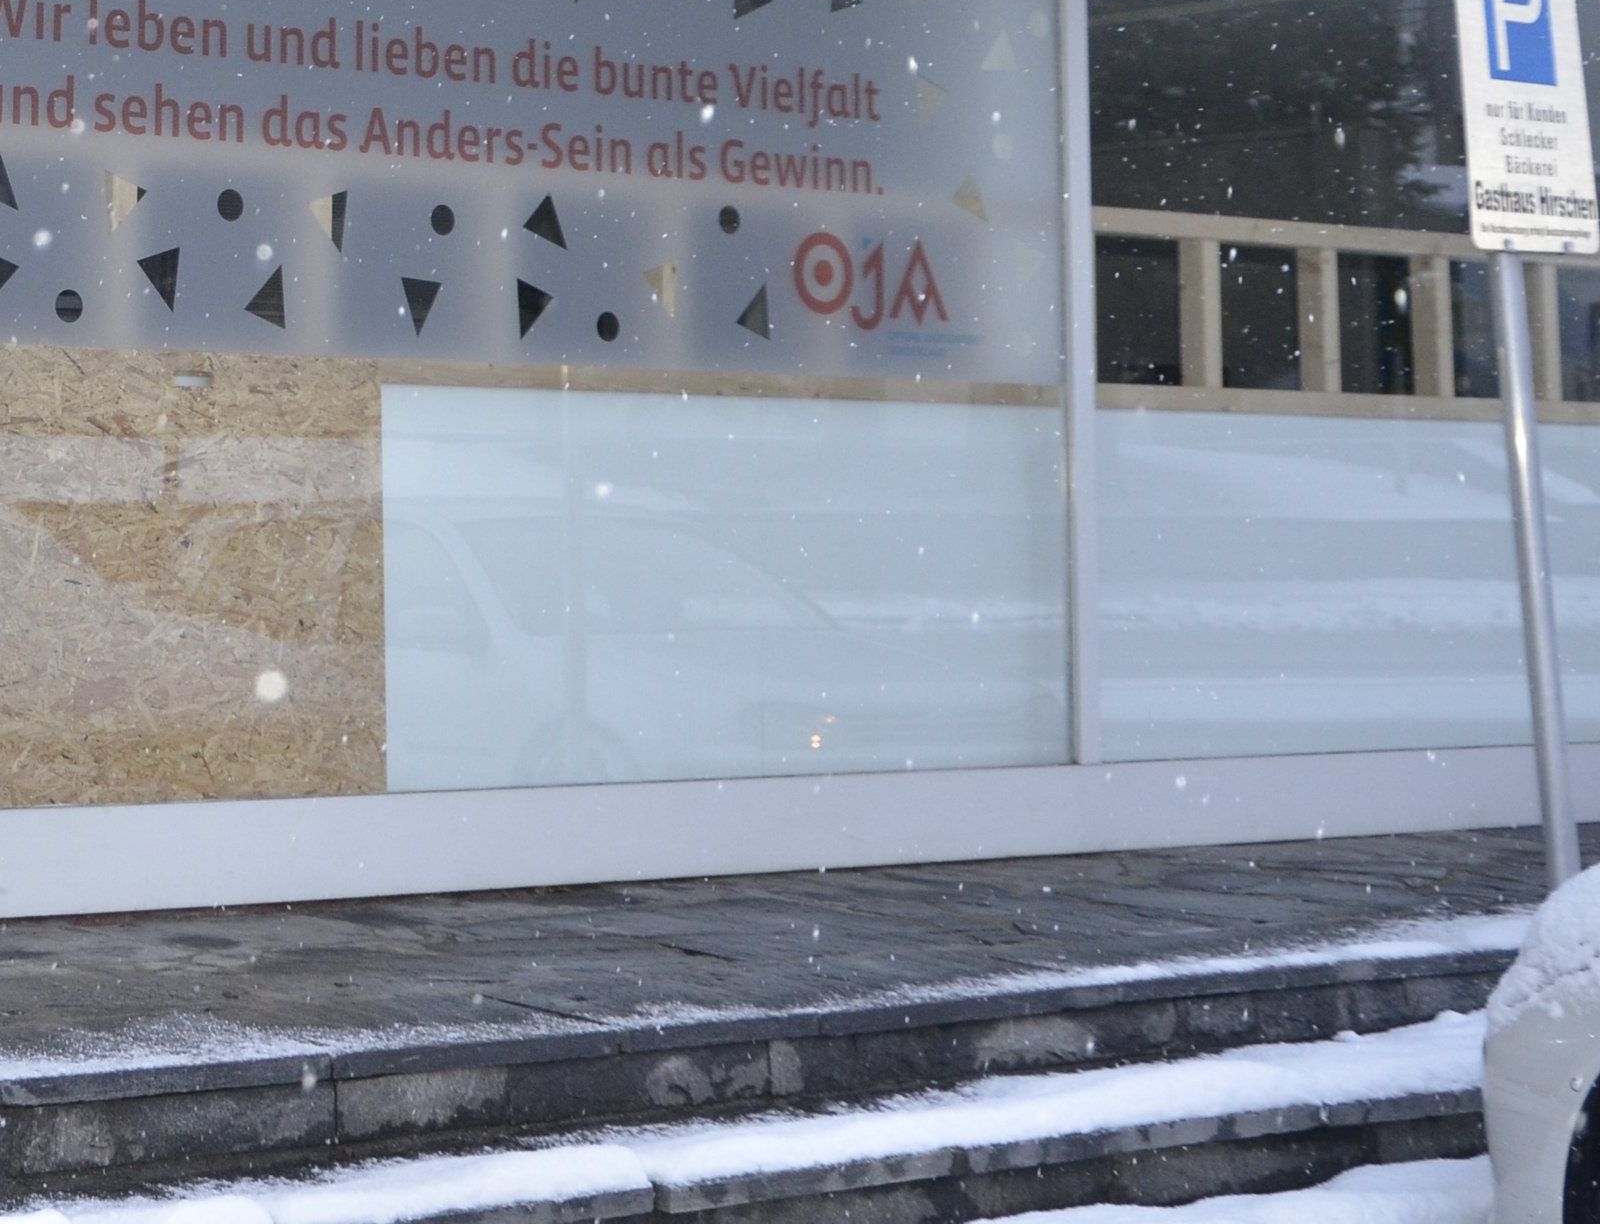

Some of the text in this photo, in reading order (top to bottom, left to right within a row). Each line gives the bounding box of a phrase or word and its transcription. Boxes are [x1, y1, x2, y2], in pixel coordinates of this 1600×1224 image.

[246, 16, 341, 70] und
[355, 19, 497, 84] lieben
[512, 38, 580, 93] die
[593, 44, 720, 106] bunte
[727, 63, 882, 128] Vielfalt
[1485, 99, 1568, 125] nur für Kunden
[93, 82, 245, 144] sehen
[261, 93, 349, 153] das
[358, 106, 633, 176] Anders-Sein
[646, 129, 707, 181] als
[719, 137, 885, 196] Gewinn.
[1500, 126, 1559, 150] Schlecker
[1504, 154, 1559, 177] Bäckerei
[1475, 180, 1599, 221] Gasthaus Hirschen
